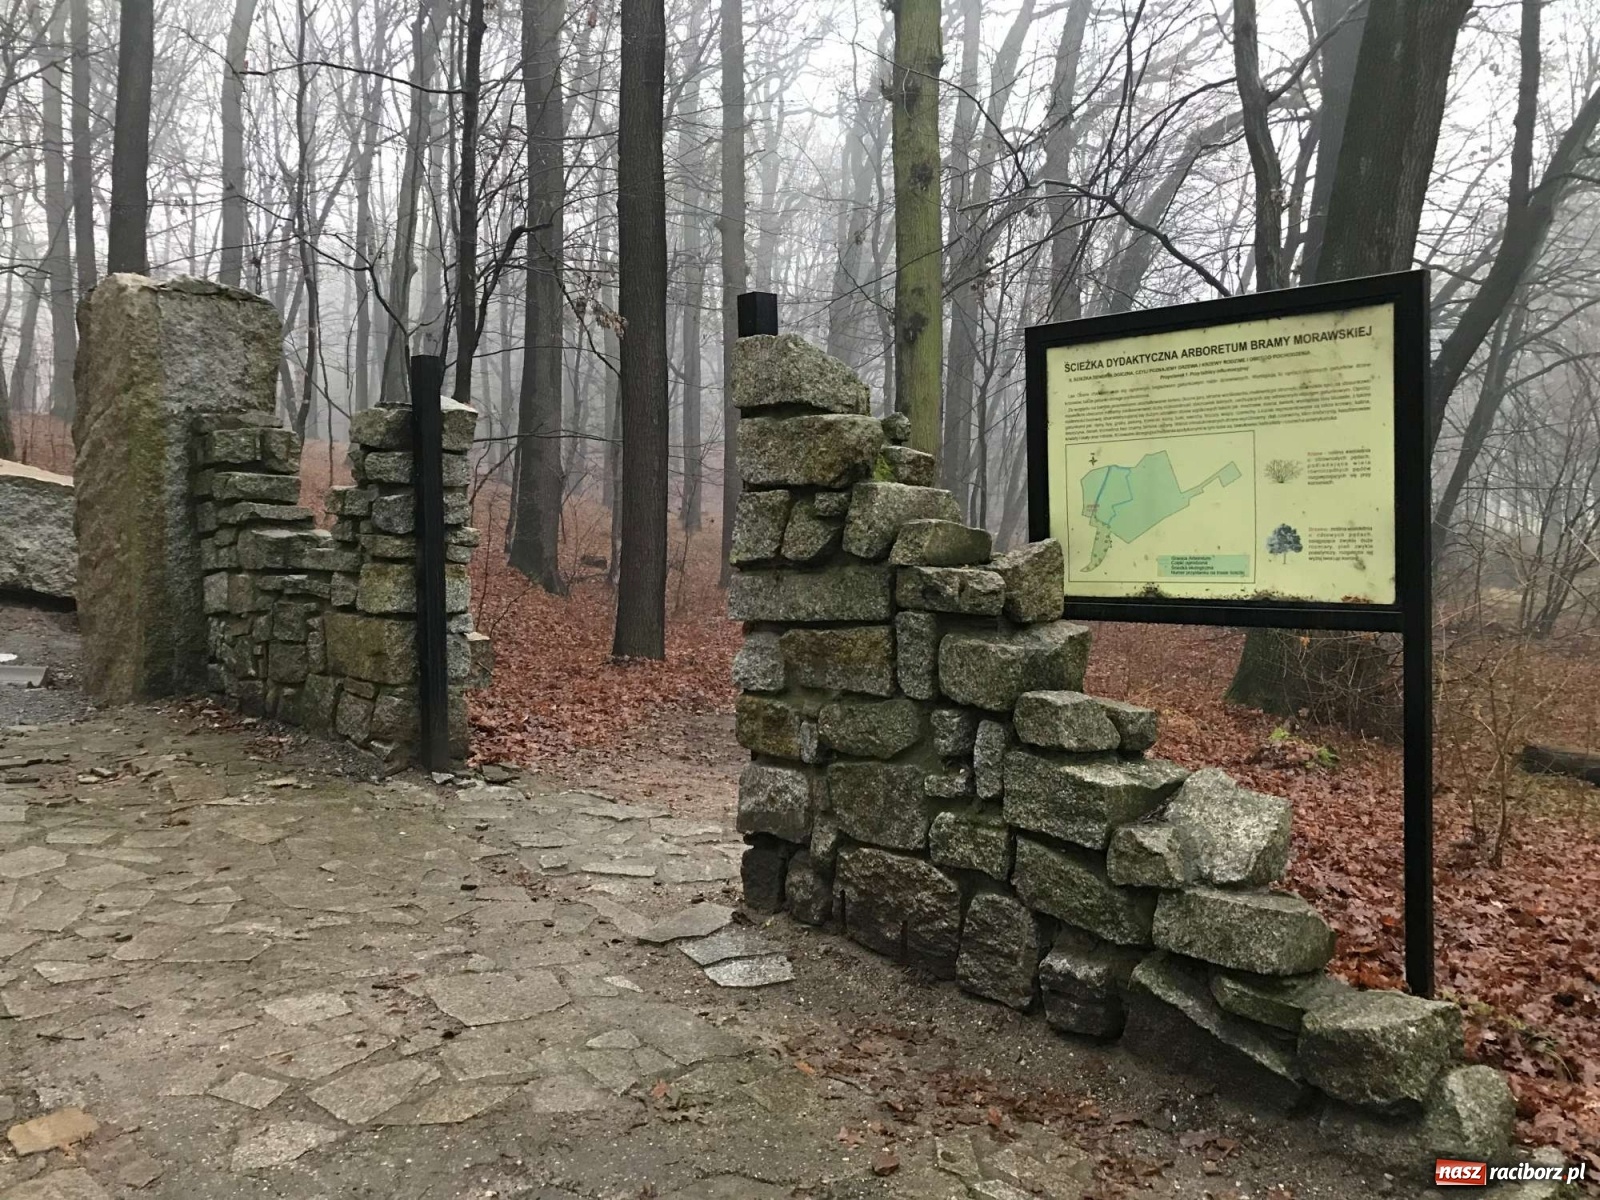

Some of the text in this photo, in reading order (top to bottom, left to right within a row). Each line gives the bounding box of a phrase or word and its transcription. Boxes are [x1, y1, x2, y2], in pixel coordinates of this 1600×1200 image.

[1064, 325, 1373, 372] ŚCIEŻKA DYDAKTYCZNA ARBORETUM BRAMY MORAWSKIEJ
